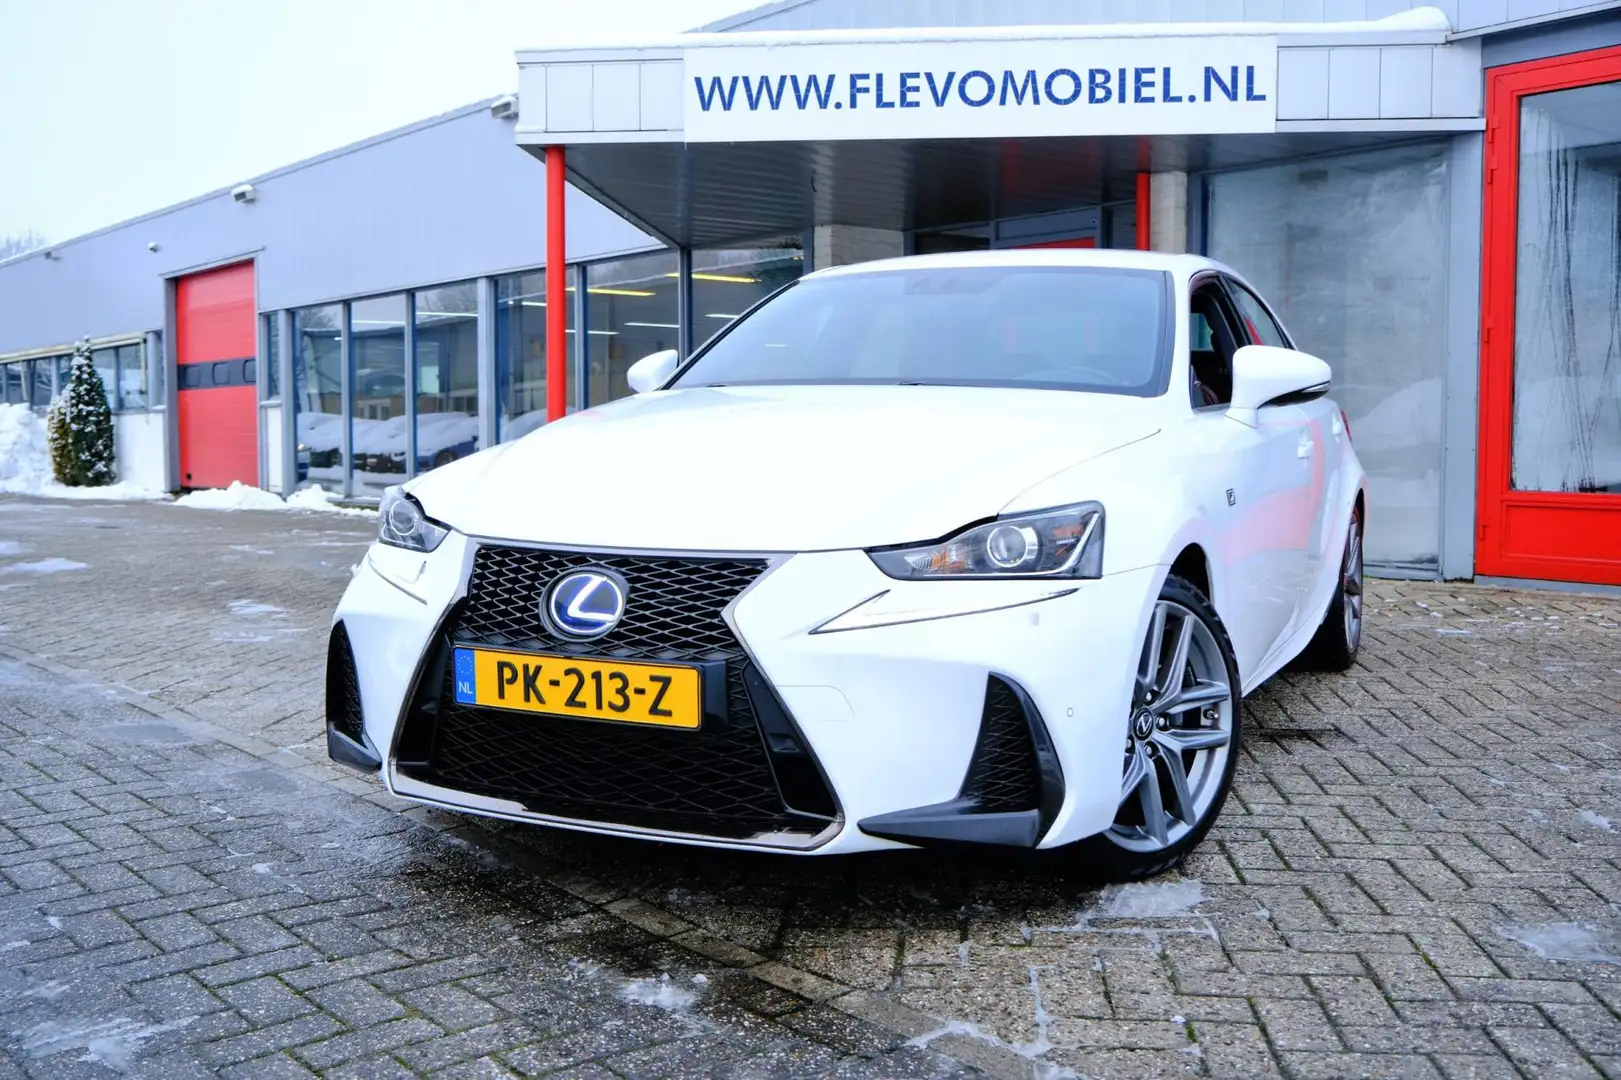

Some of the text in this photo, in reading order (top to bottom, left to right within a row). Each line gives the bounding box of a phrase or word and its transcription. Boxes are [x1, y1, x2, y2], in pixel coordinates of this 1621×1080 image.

[694, 64, 1266, 112] WWW.FLEVOMOBIEL.NL
[458, 680, 473, 695] NL
[496, 660, 673, 717] PK-213-Z
